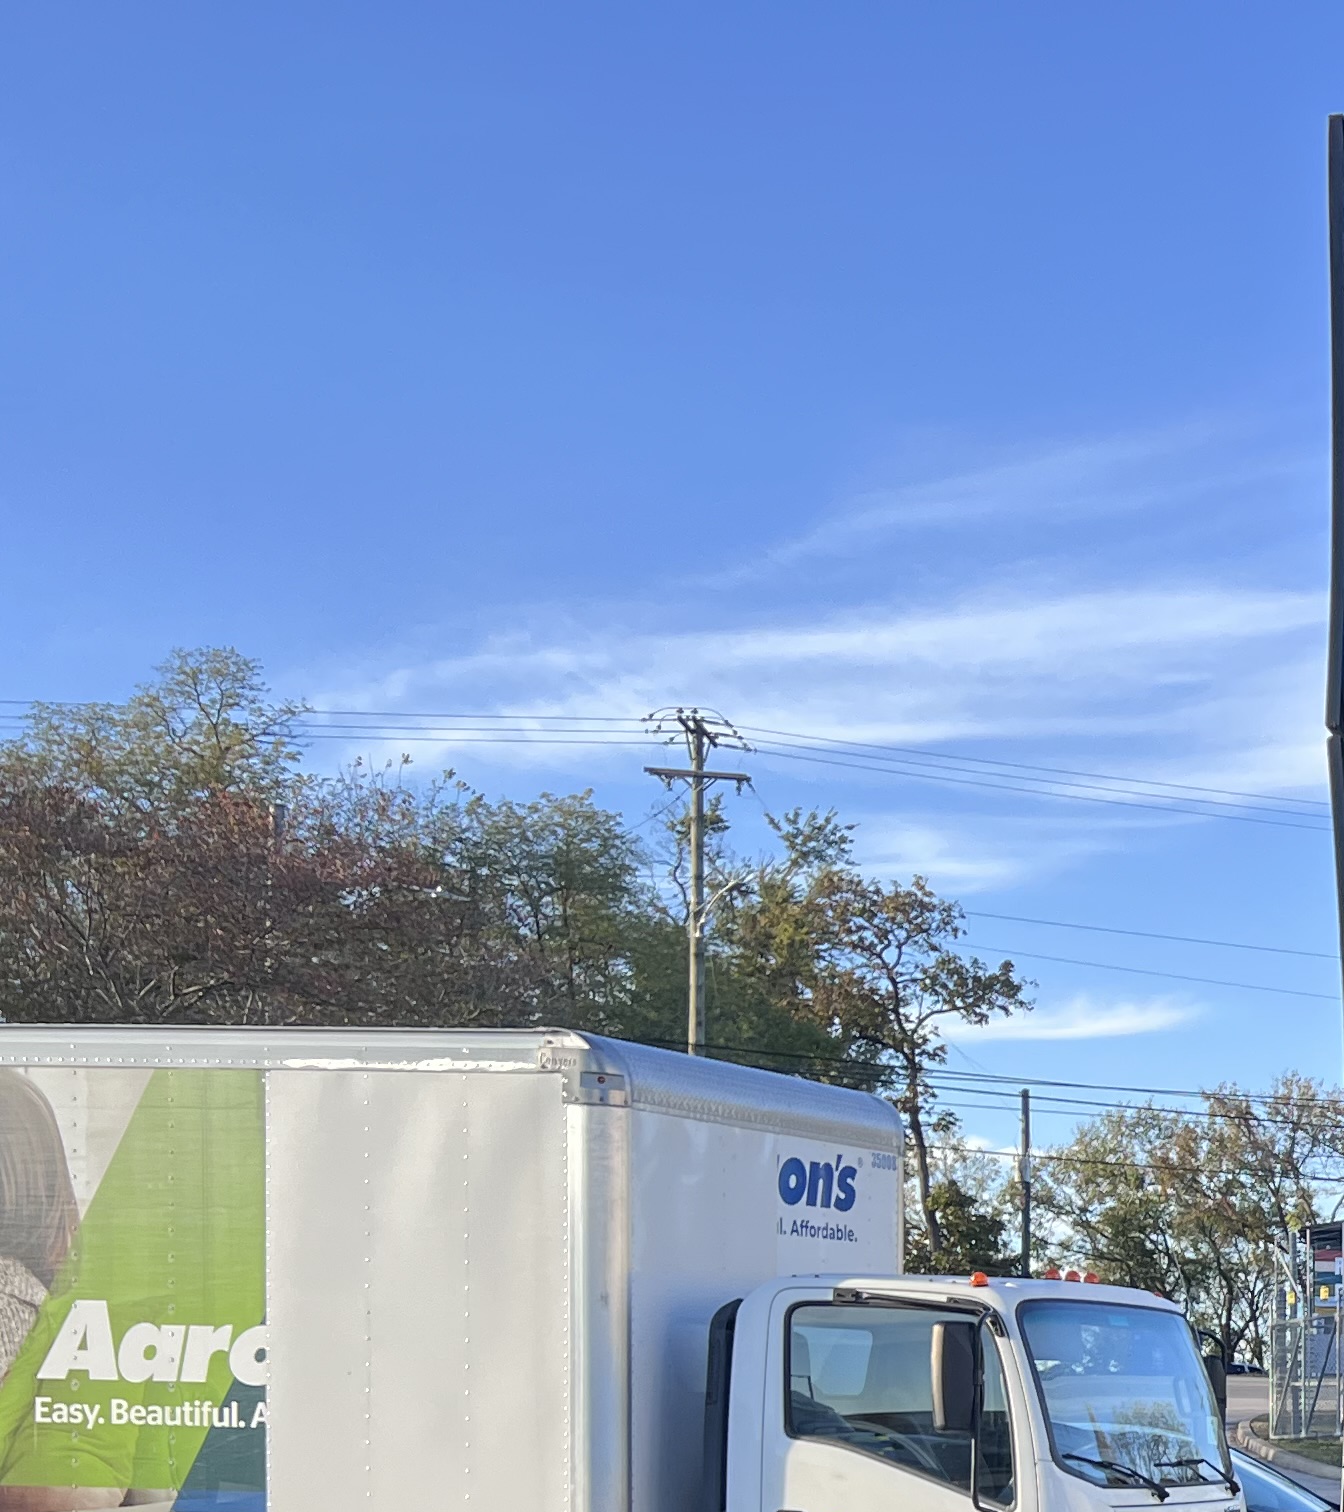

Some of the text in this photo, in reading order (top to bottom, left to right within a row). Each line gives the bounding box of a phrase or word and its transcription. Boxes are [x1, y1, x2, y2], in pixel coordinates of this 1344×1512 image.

[778, 1154, 857, 1212] on's
[790, 1220, 858, 1242] Affordable.
[34, 1396, 105, 1430] Easy.
[110, 1399, 246, 1428] Beautiful.
